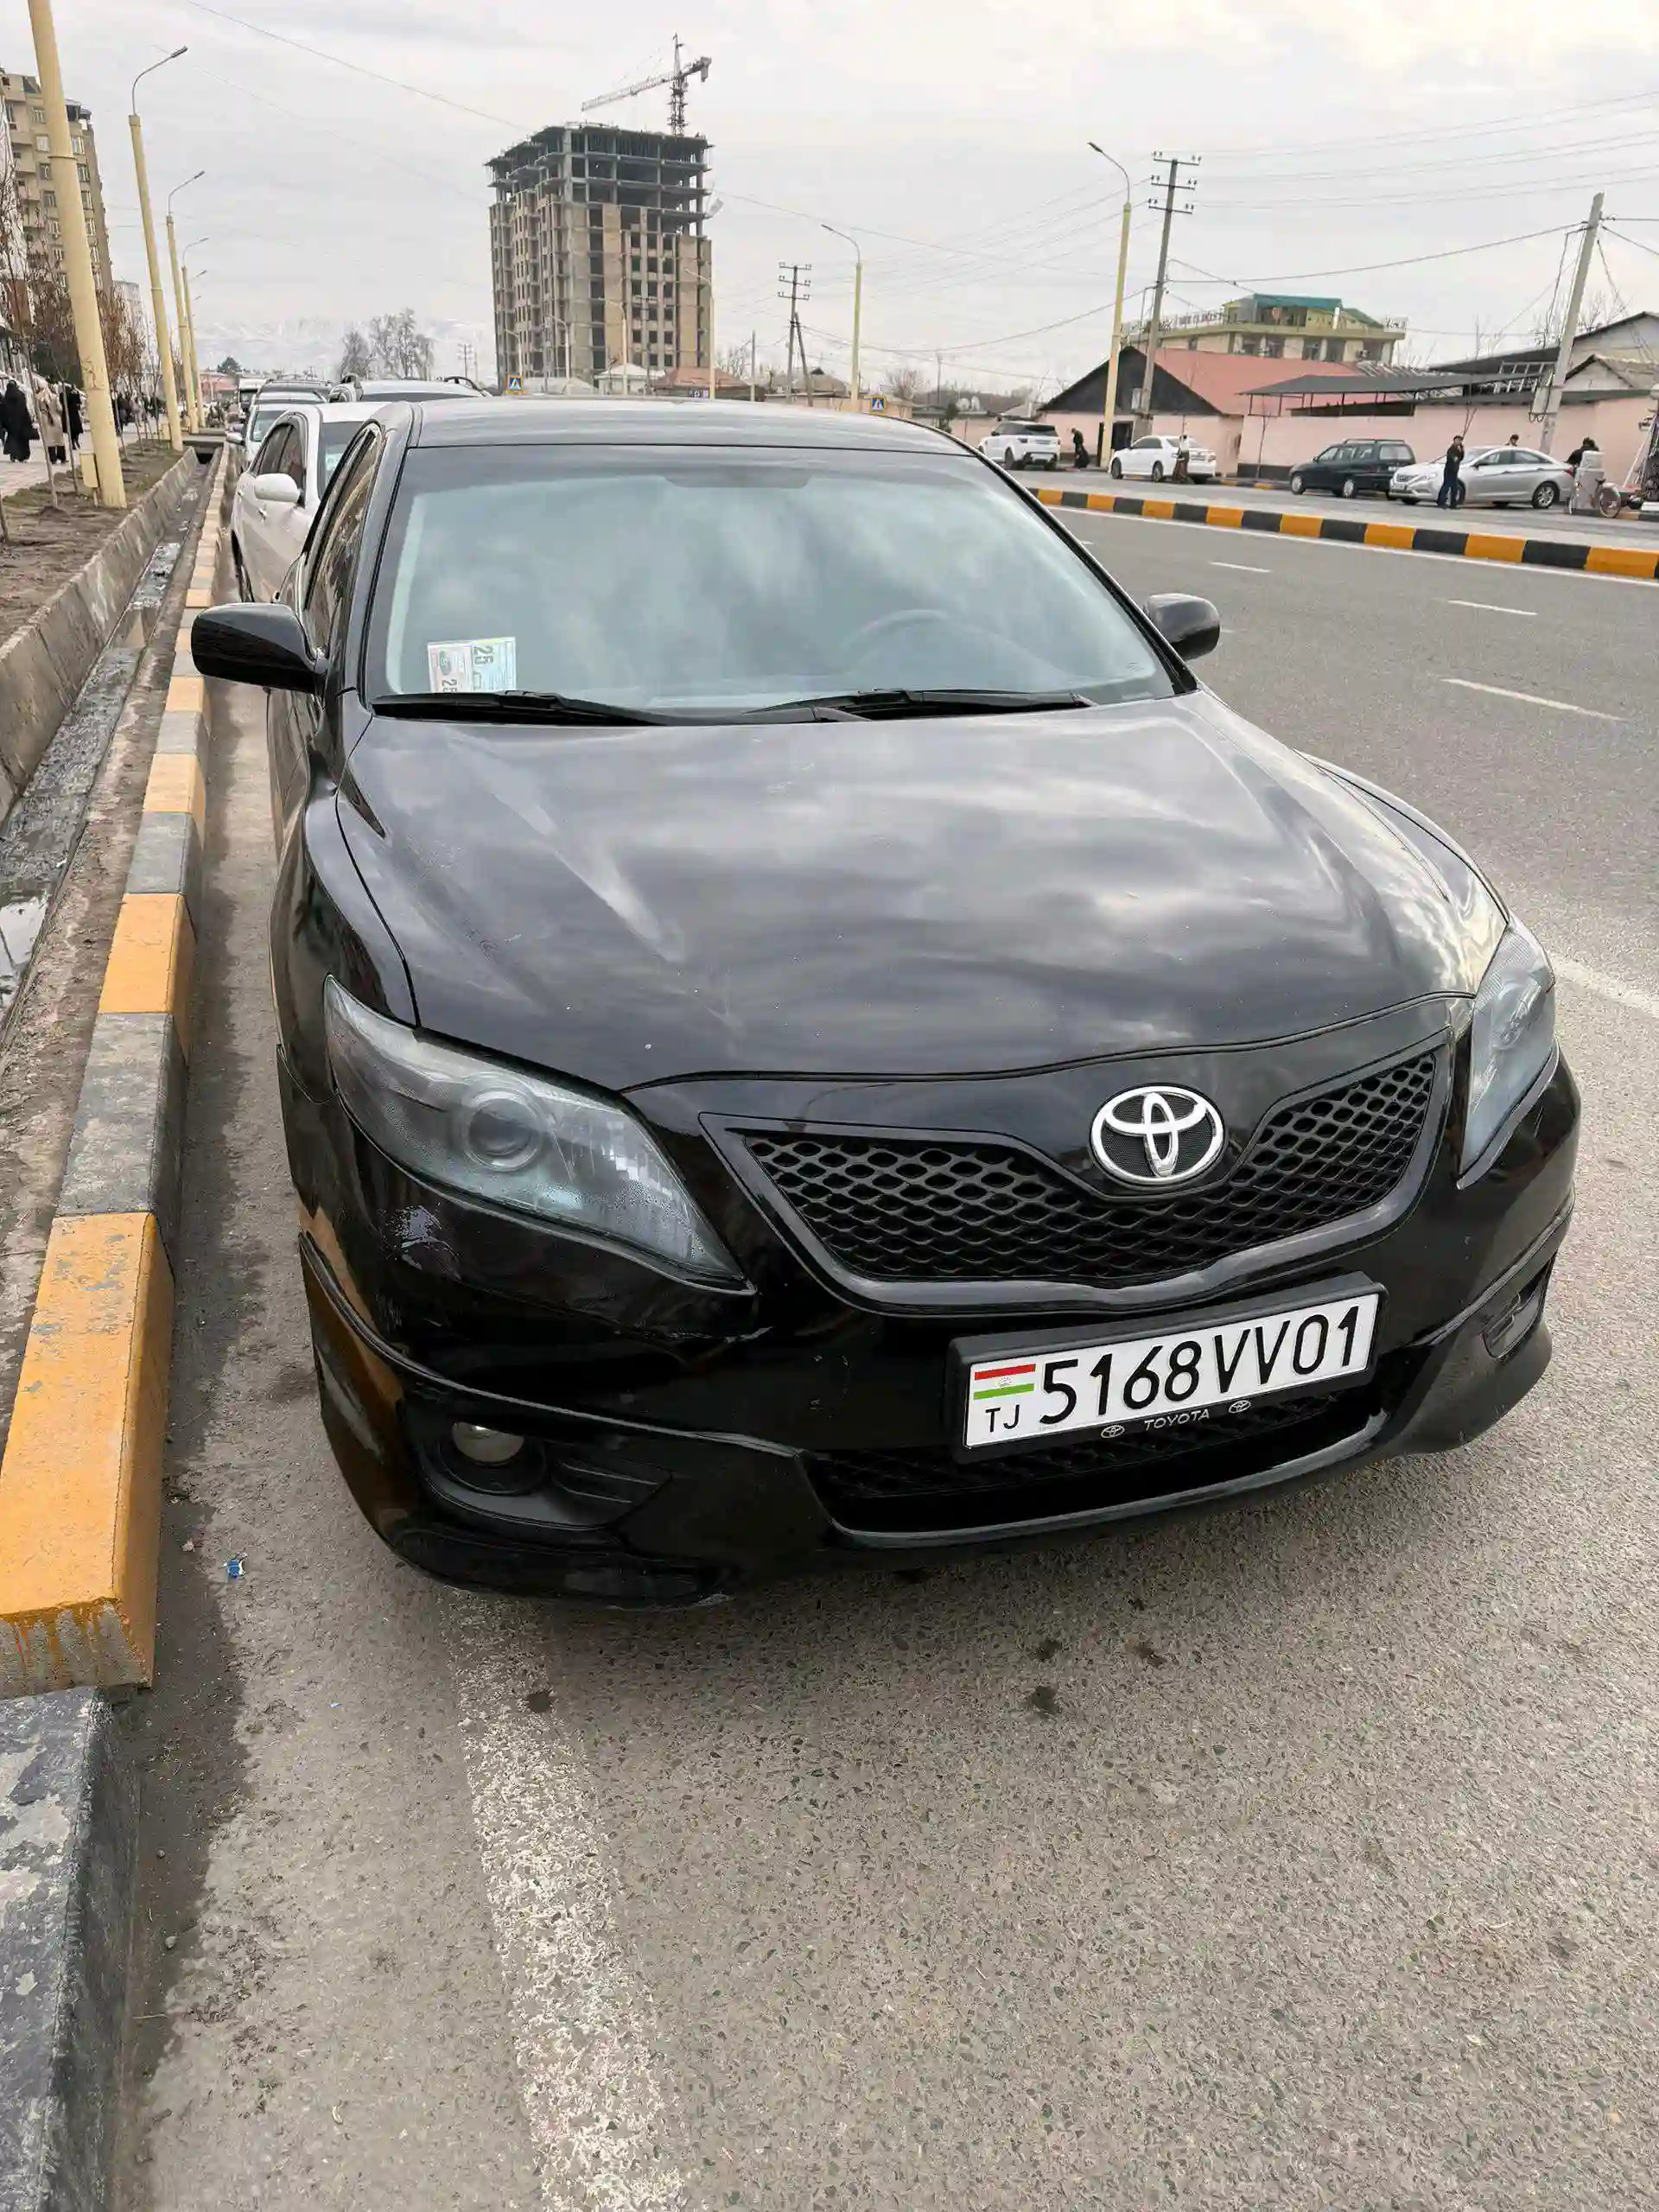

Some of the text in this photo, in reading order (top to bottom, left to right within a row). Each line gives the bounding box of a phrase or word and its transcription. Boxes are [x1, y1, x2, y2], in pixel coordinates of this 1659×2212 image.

[474, 645, 493, 664] 25
[985, 1404, 1020, 1433] TJ
[1144, 1408, 1210, 1430] TOYOTA
